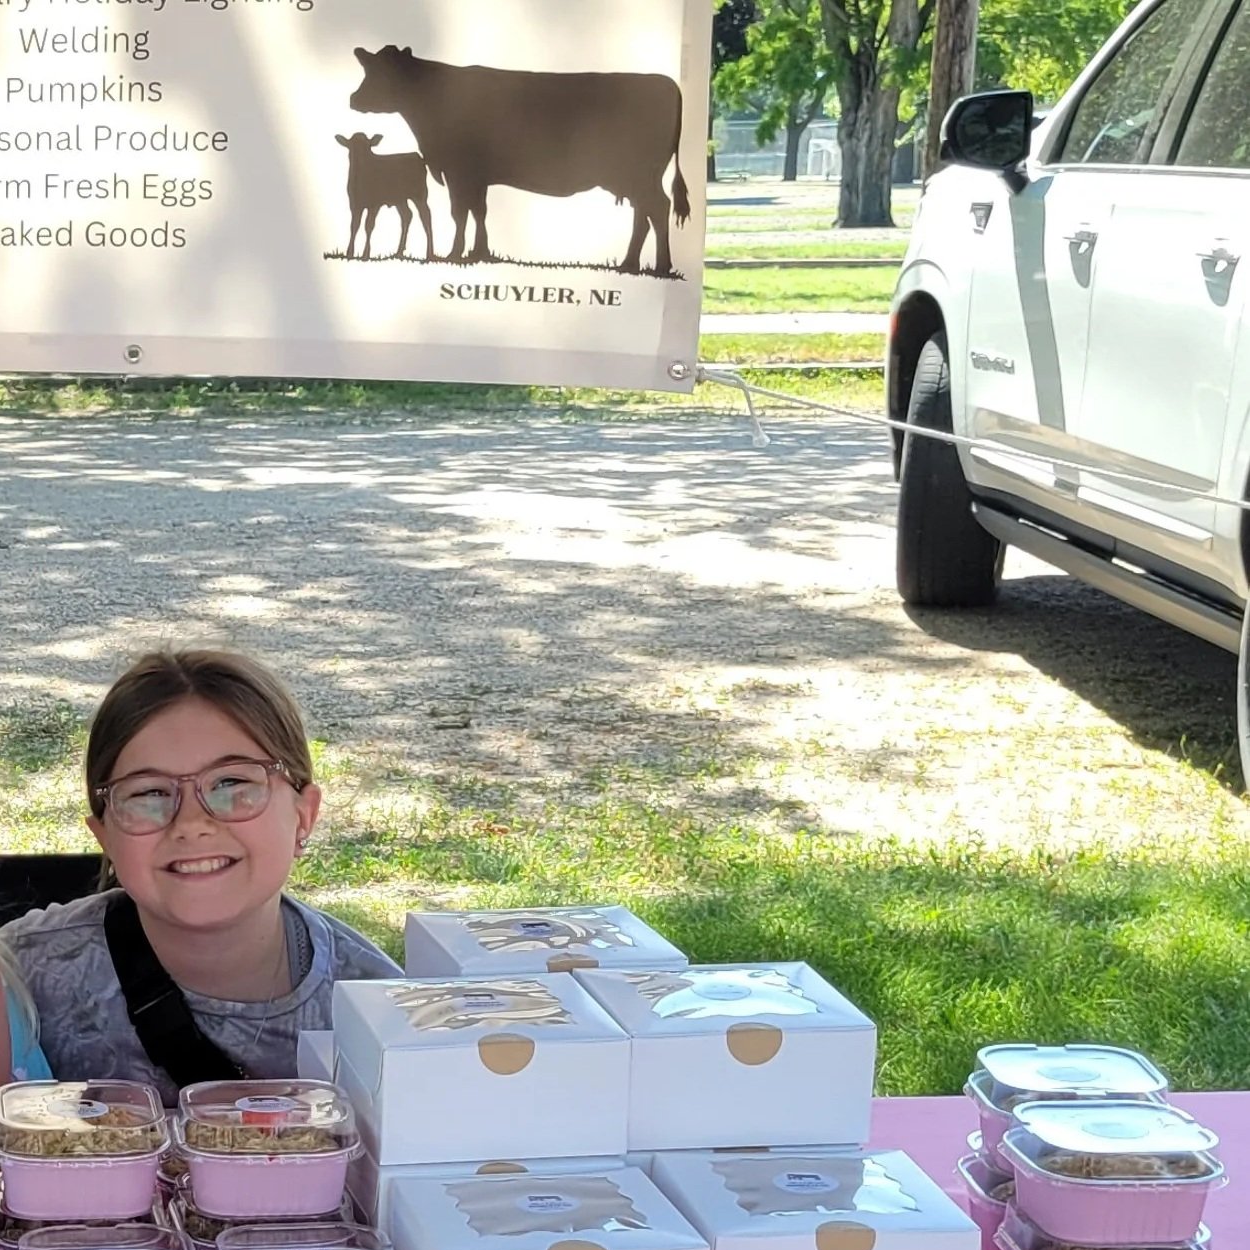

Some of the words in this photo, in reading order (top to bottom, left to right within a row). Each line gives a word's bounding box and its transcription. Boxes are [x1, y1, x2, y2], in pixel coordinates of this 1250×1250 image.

[19, 25, 150, 60] Welding
[6, 74, 163, 109] Pumpkins
[94, 124, 229, 151] Produce
[44, 172, 129, 199] Fresh
[143, 173, 213, 207] Eggs
[85, 220, 187, 248] Goods
[439, 283, 582, 306] SCHUYLER,
[588, 288, 622, 306] NE
